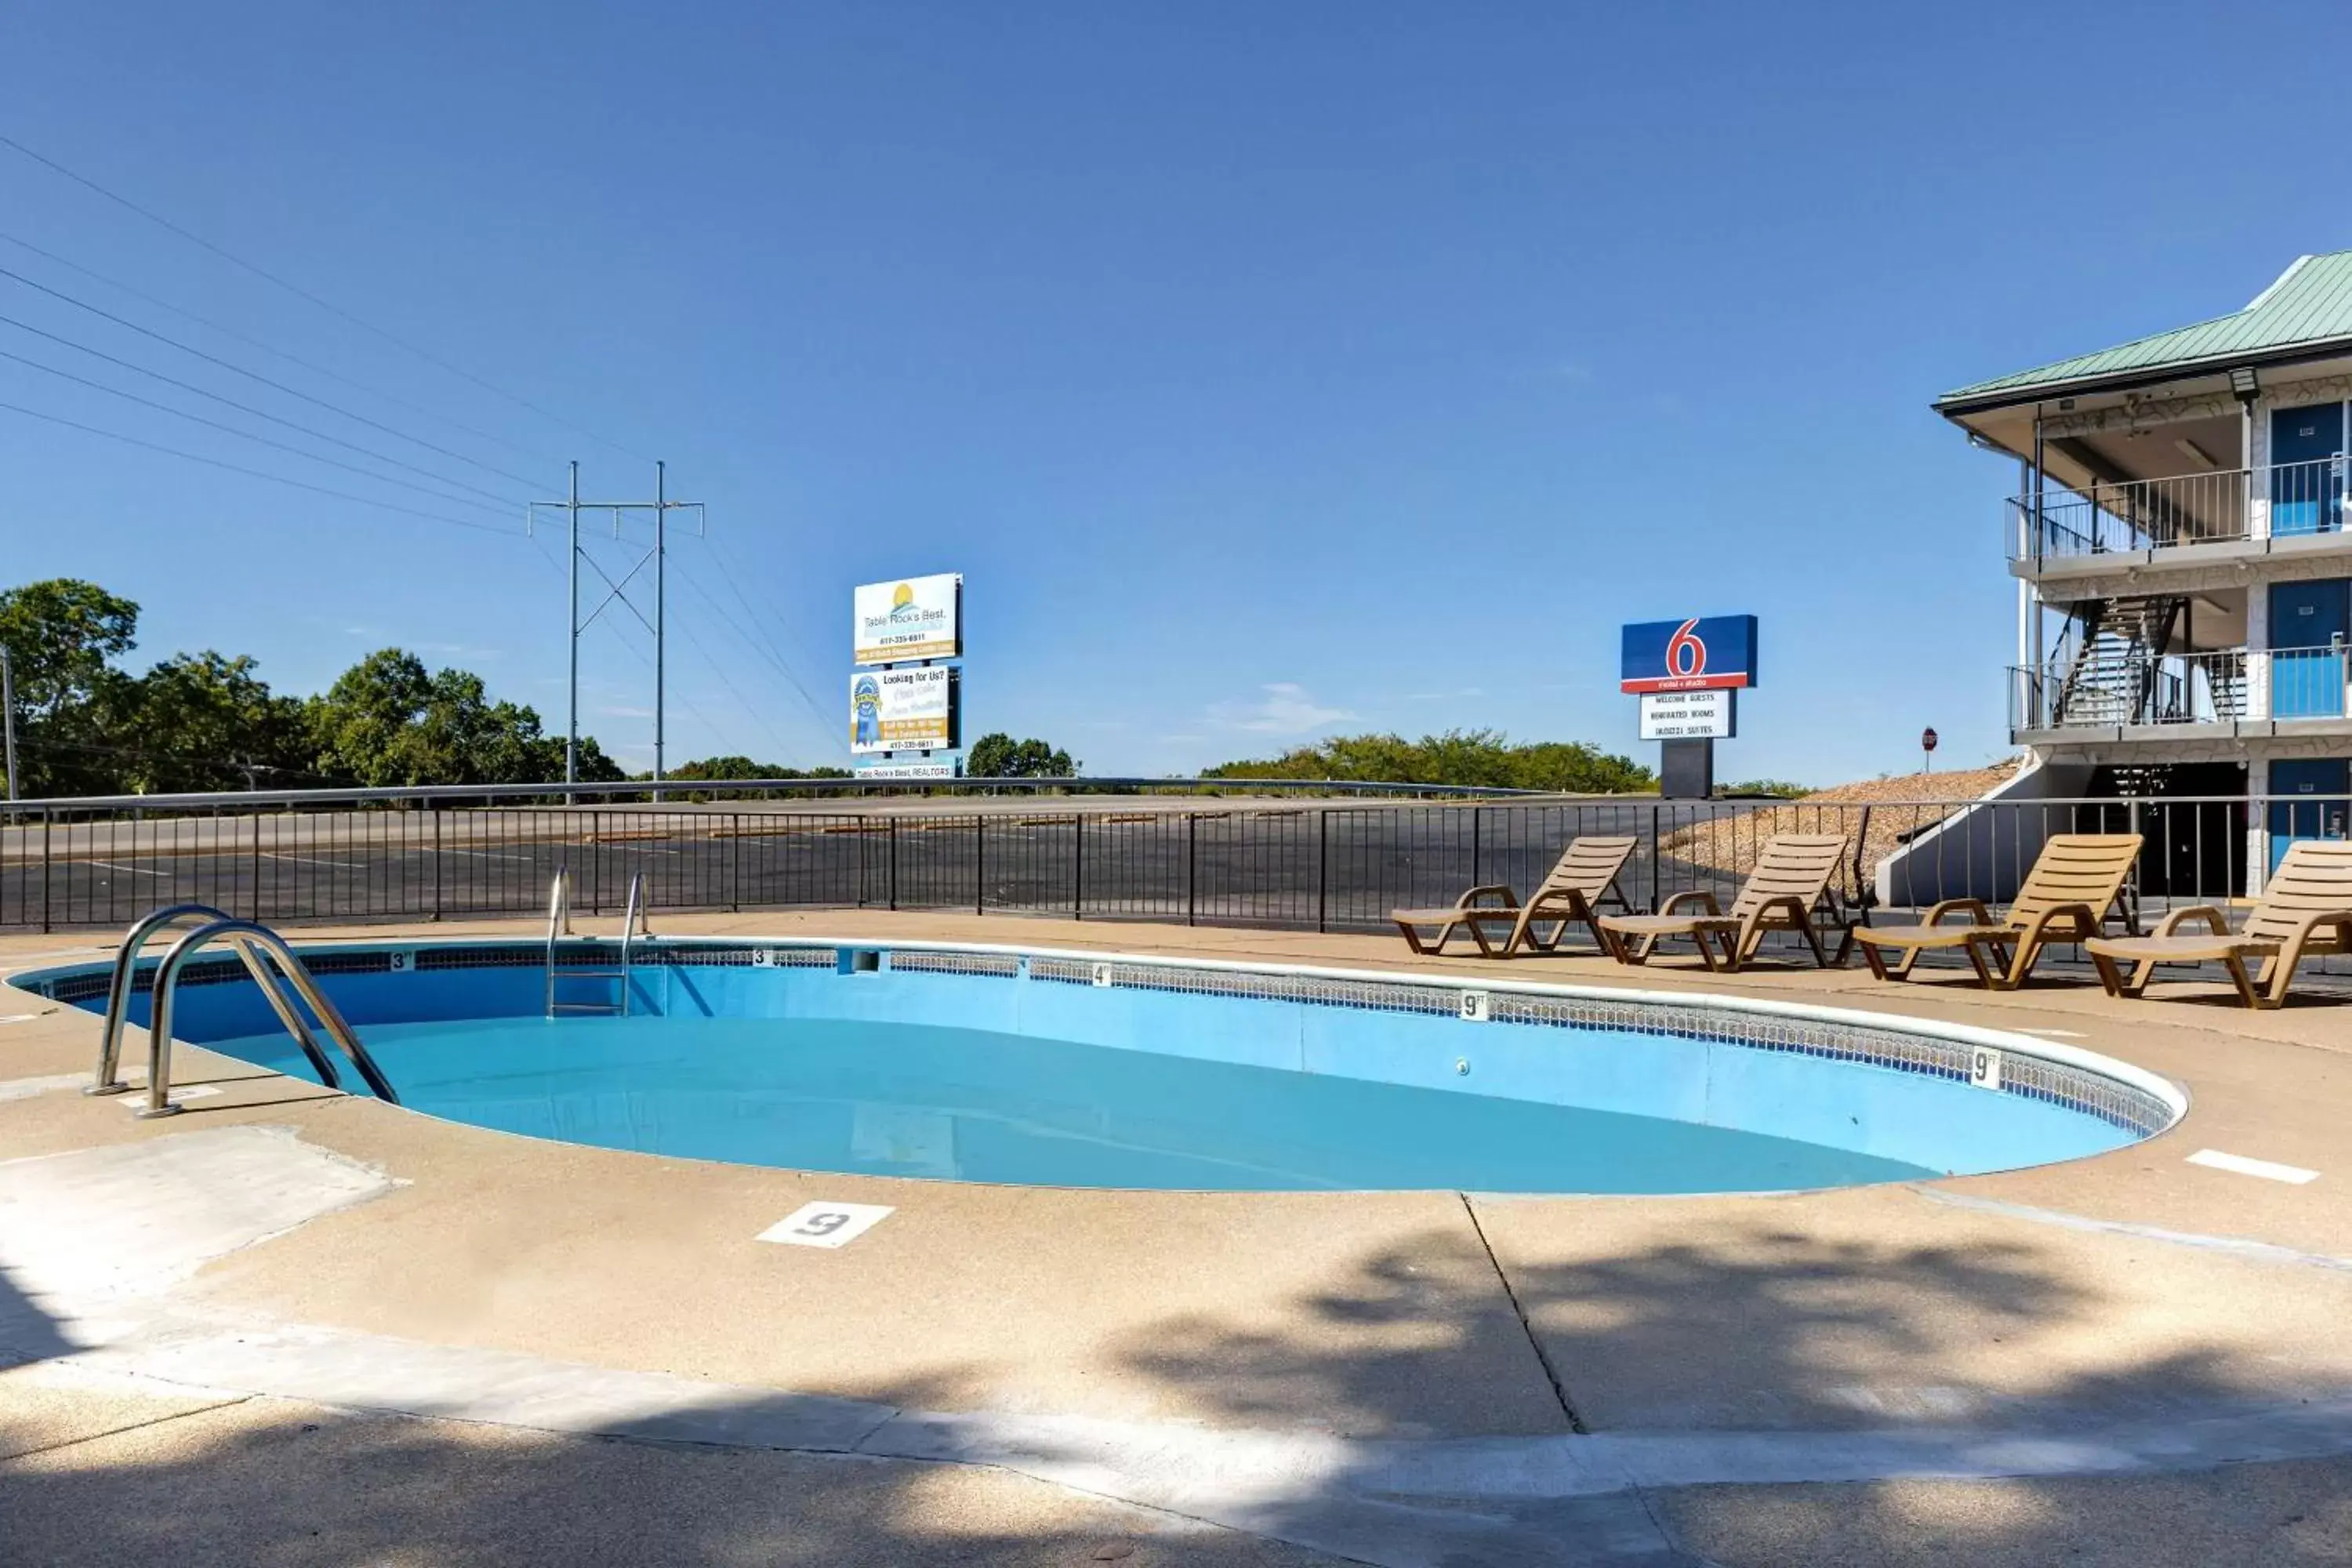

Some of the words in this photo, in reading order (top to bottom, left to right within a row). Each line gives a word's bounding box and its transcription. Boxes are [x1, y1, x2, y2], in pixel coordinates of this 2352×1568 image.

[865, 615, 887, 627] Table
[1666, 617, 1707, 677] 6
[884, 675, 913, 684] Looking
[916, 672, 927, 681] for
[929, 670, 945, 681] Us?
[1655, 695, 1686, 703] WELCOME
[1691, 710, 1715, 718] ROOMS
[1687, 725, 1713, 735] SUITES
[1465, 995, 1476, 1017] 9
[1975, 1052, 1987, 1081] 9
[792, 1213, 851, 1236] 9
